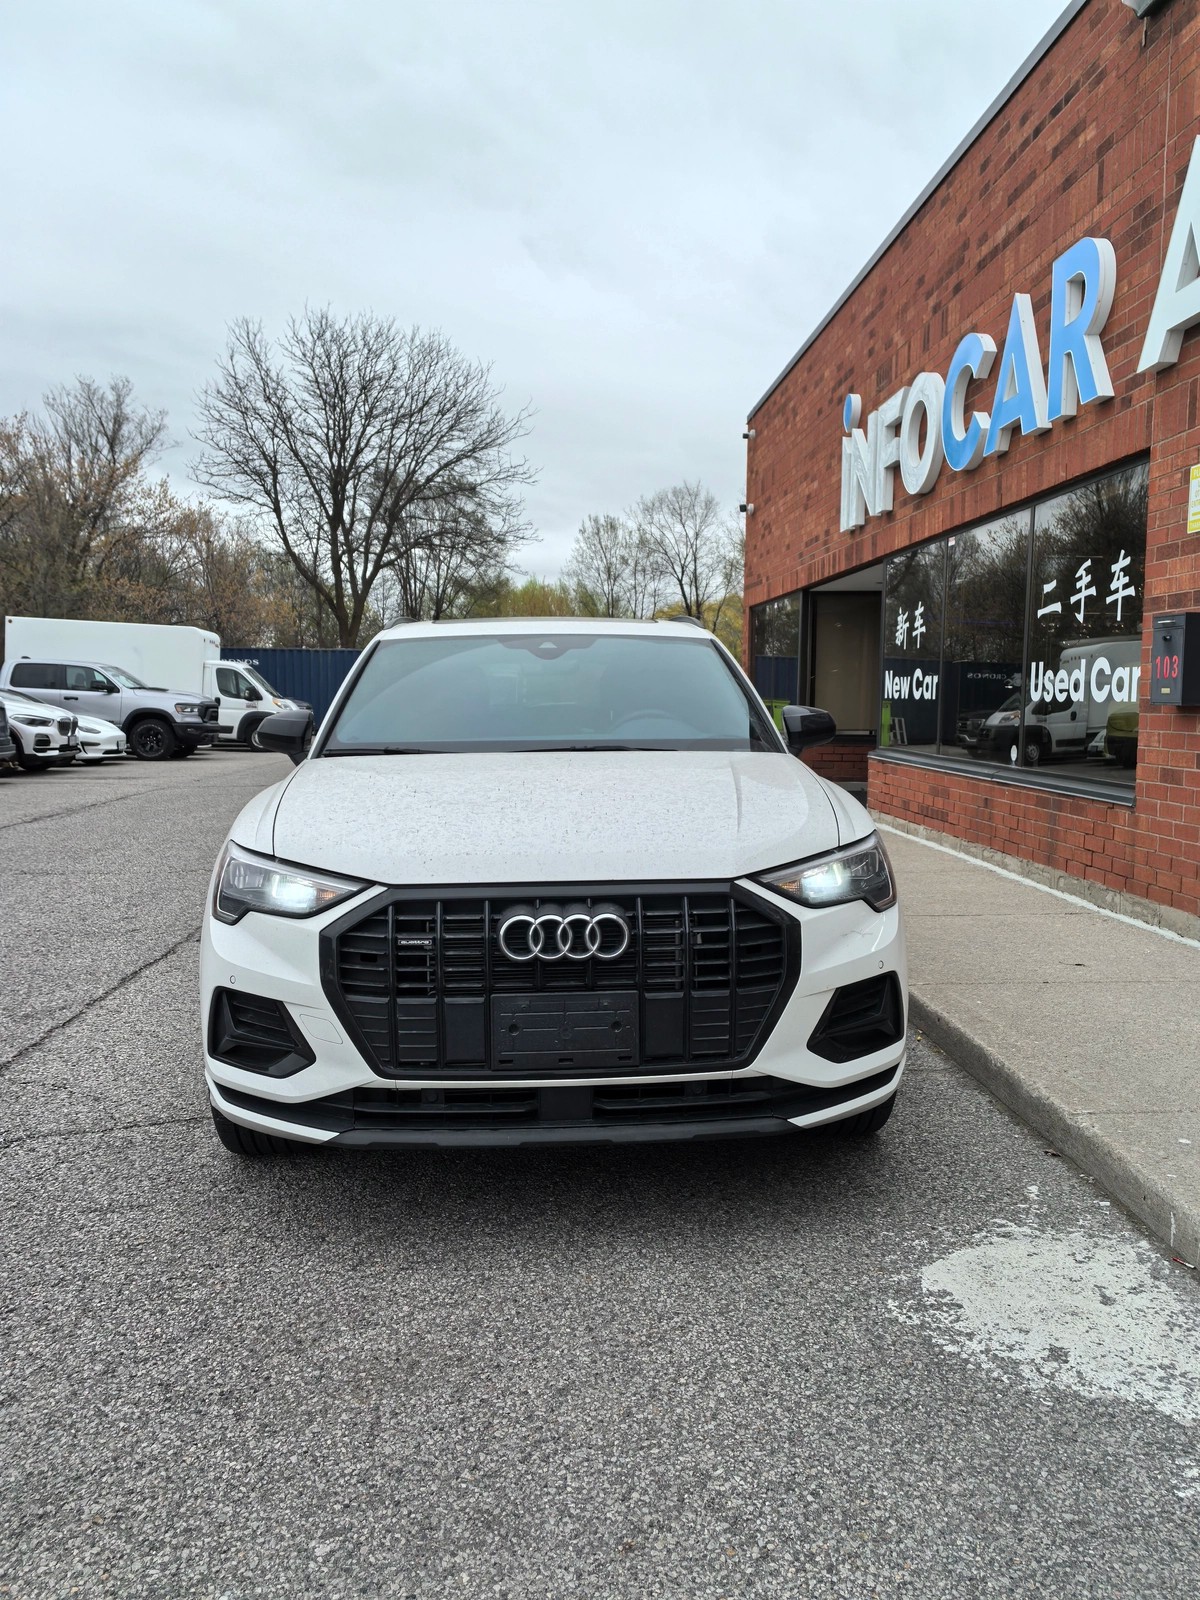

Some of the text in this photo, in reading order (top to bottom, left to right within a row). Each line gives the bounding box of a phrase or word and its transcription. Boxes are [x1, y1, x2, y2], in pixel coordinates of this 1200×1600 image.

[1037, 549, 1136, 623] 二手车
[895, 601, 926, 650] 新车
[884, 668, 939, 700] New Car
[1030, 656, 1141, 703] Used Car
[1155, 655, 1179, 680] 103
